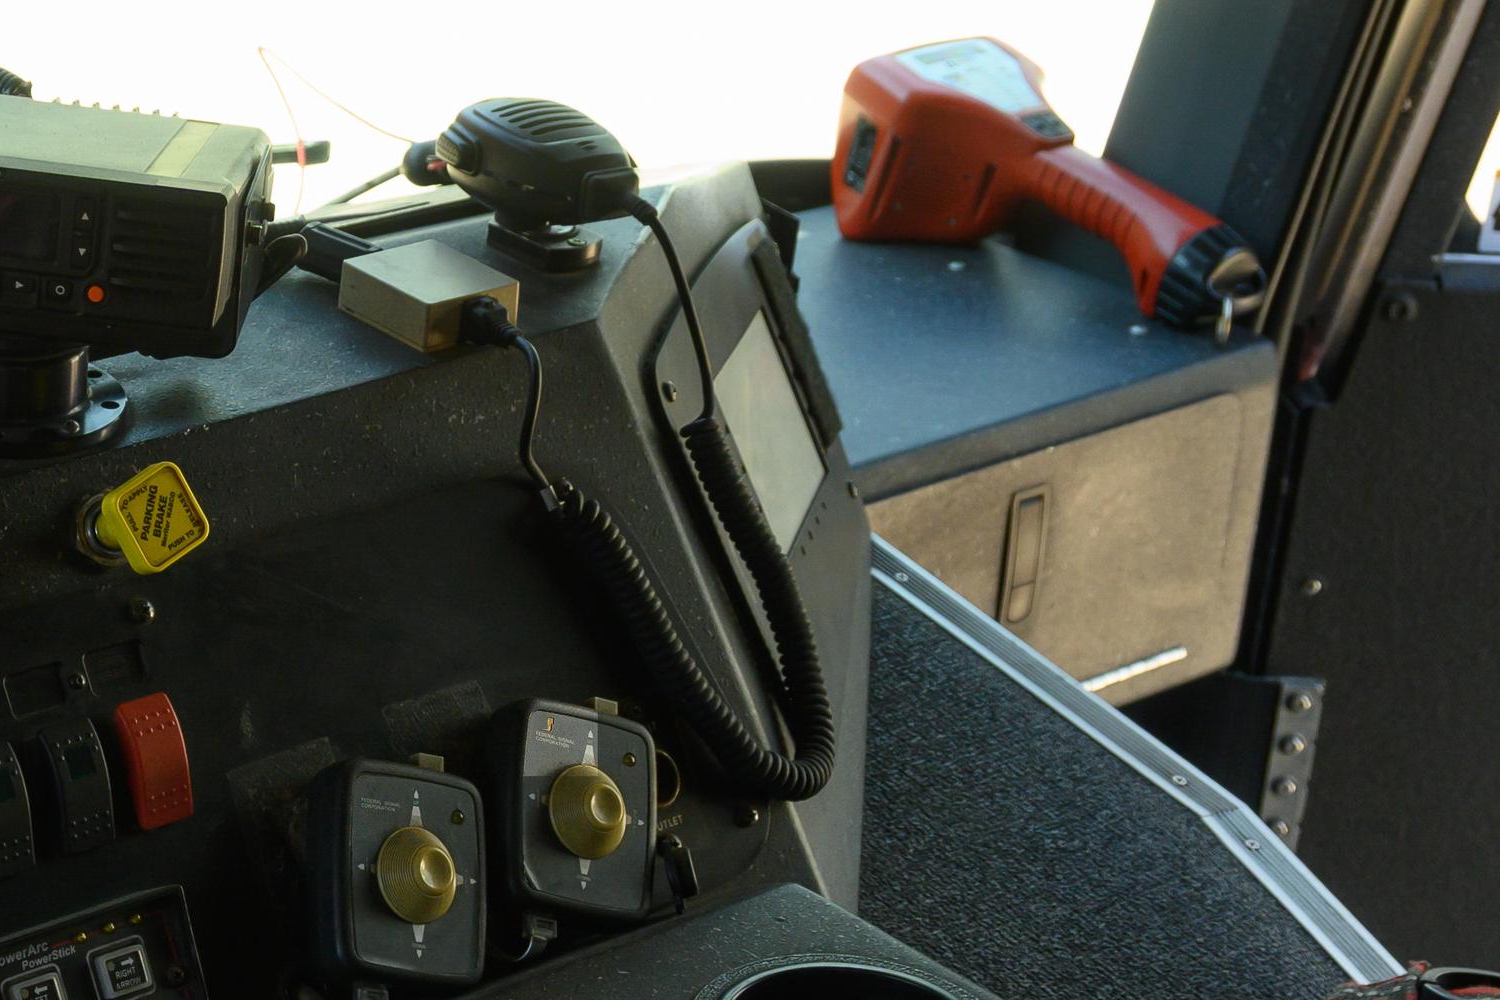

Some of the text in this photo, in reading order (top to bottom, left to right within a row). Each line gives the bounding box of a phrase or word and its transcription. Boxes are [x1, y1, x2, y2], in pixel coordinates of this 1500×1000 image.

[141, 485, 158, 541] PARKING
[153, 495, 168, 537] BRAKE
[657, 814, 683, 831] UTLET
[22, 945, 76, 971] PowerStick
[115, 966, 136, 979] RIGHT
[116, 977, 141, 990] ARROW
